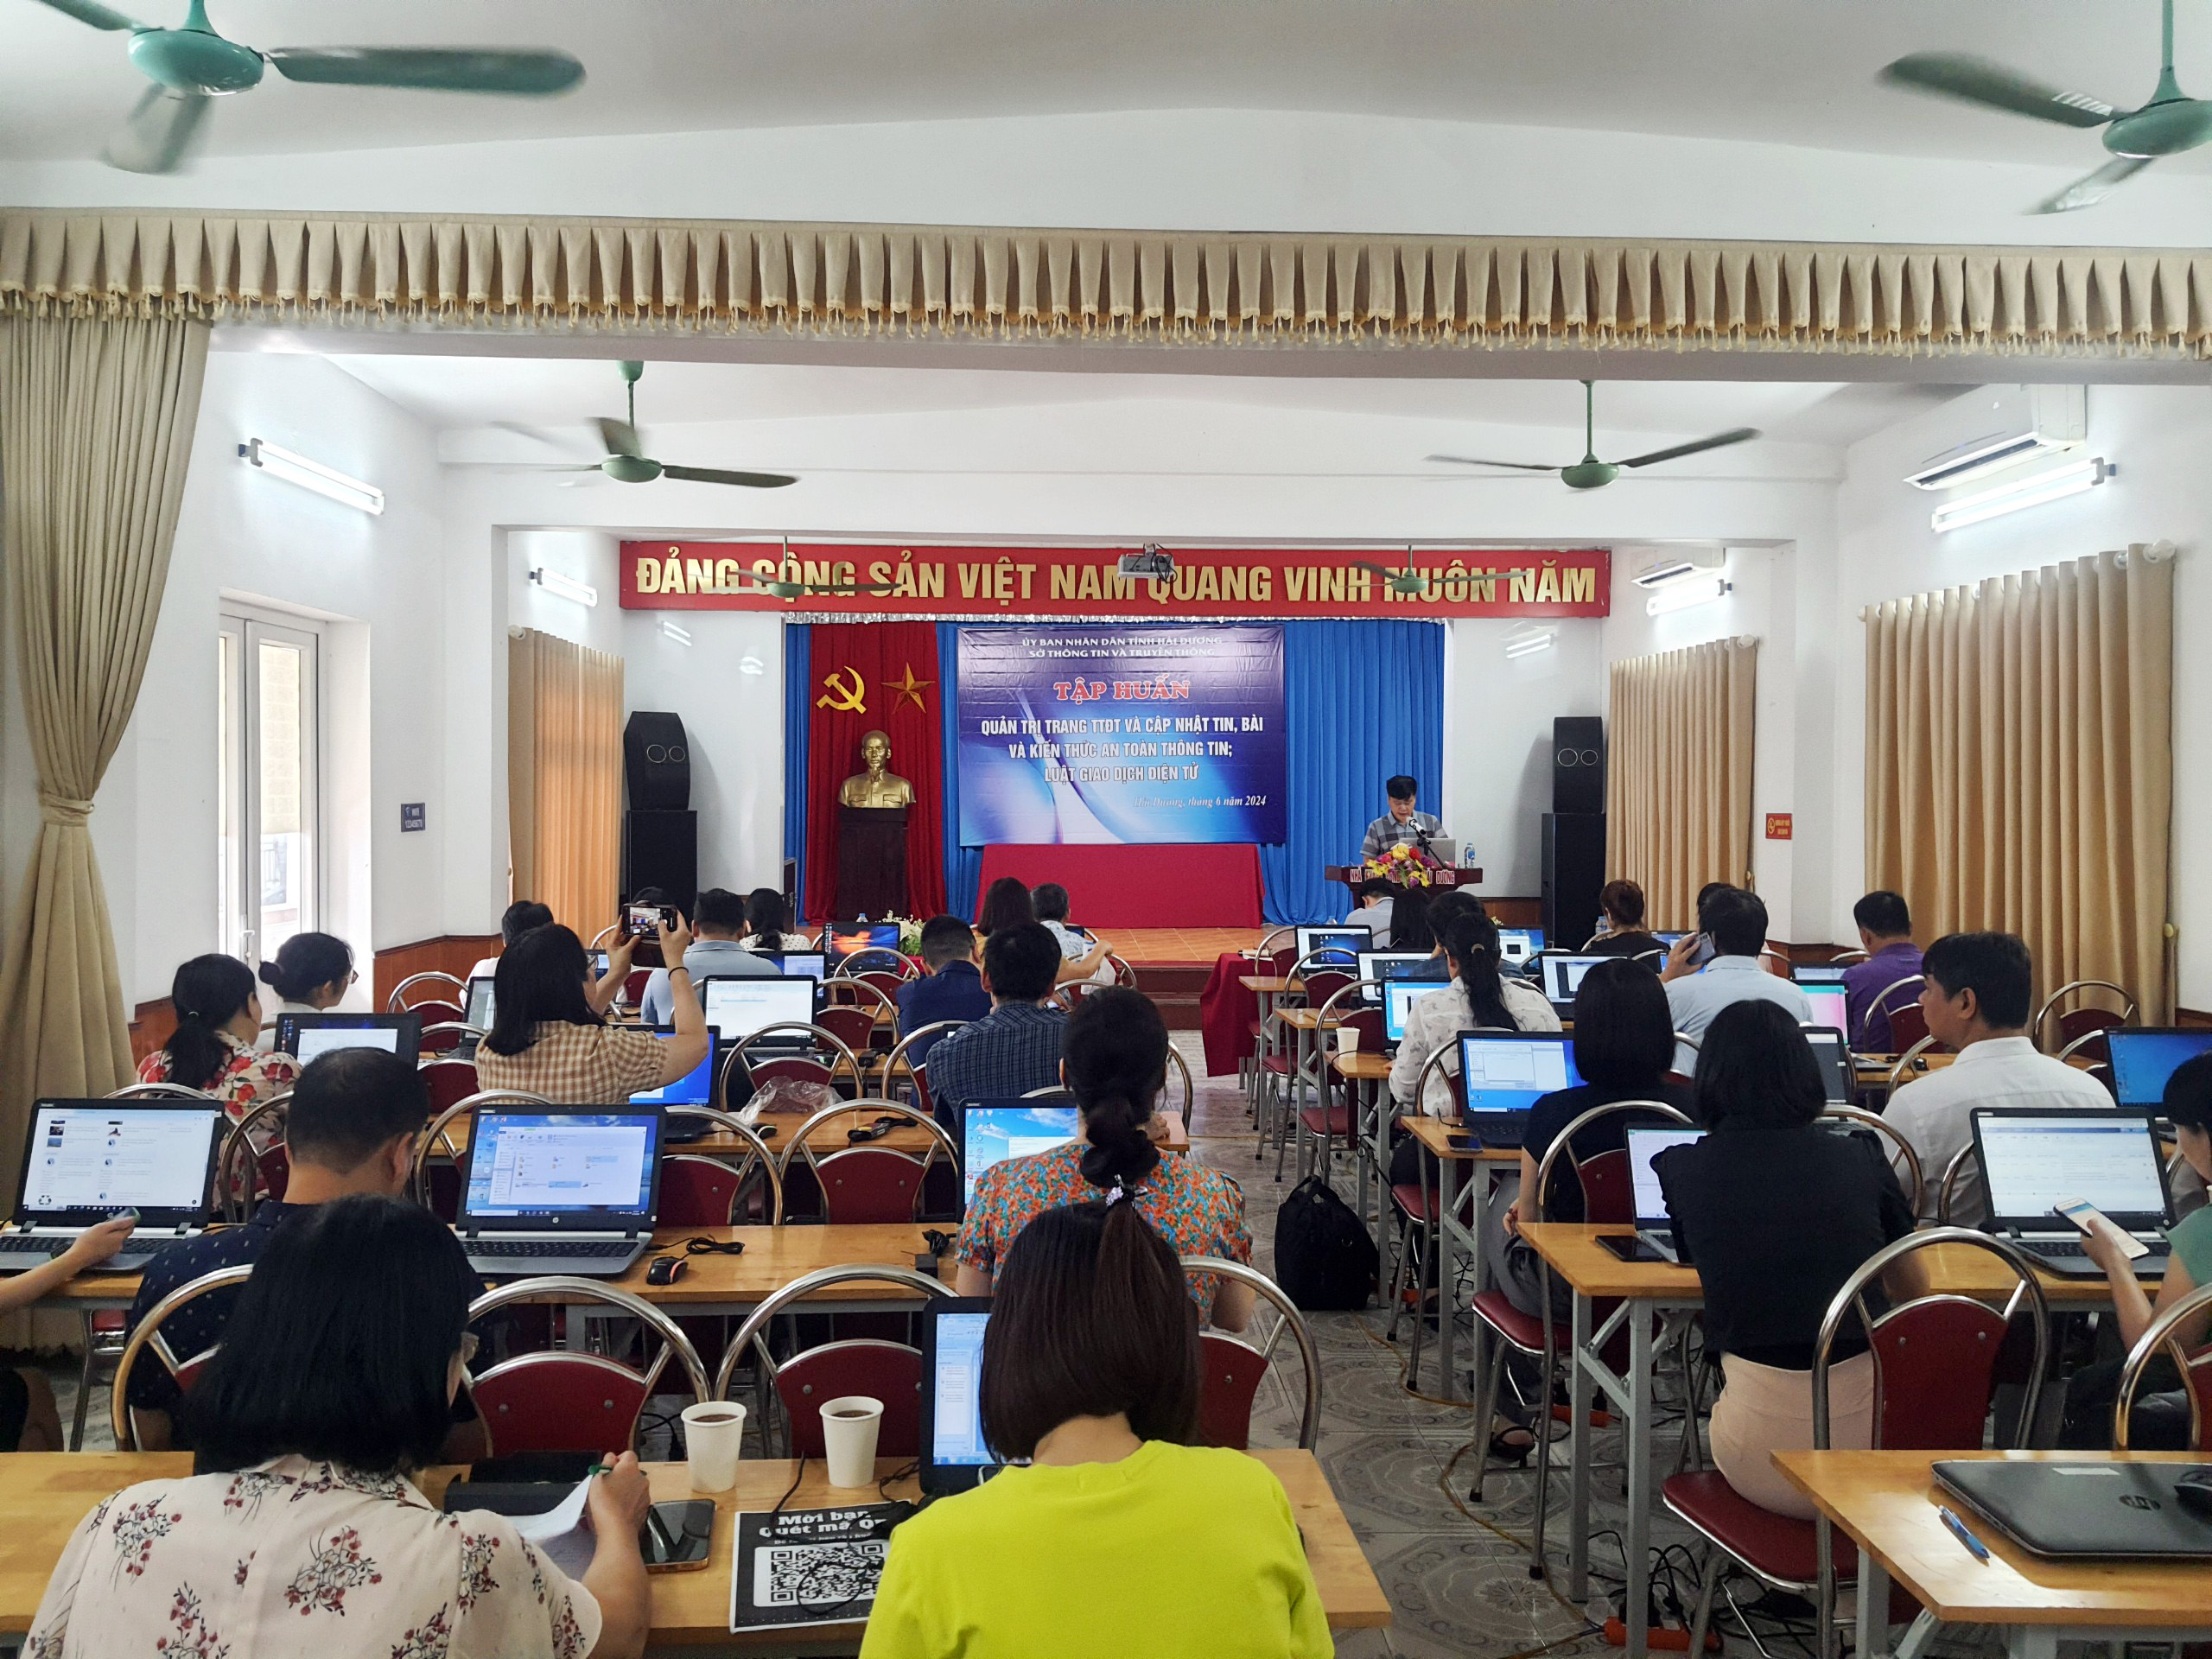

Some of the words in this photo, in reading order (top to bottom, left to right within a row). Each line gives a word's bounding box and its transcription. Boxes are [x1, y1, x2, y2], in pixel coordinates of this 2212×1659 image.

[636, 546, 740, 594] ĐẢNG
[753, 552, 855, 602] CỘNG
[868, 550, 944, 598] SẢN
[957, 556, 1037, 606] VIỆT
[1051, 564, 1135, 600] NAM
[1147, 564, 1272, 605] QUANG
[1283, 566, 1371, 602] VINH
[1384, 559, 1497, 602] MUÔN
[1509, 559, 1596, 603] NĂM
[1039, 638, 1063, 646] BAN
[1065, 637, 1098, 646] NHÂN
[1101, 636, 1125, 645] DÂN
[1179, 636, 1223, 645] DƯƠNG
[1029, 648, 1045, 658] SỞ
[1047, 648, 1089, 658] THÔNG
[1111, 647, 1127, 657] VÀ
[1175, 646, 1215, 656] THÔNG
[1053, 676, 1107, 705] TẬP
[1112, 673, 1190, 700] HUẤN
[981, 715, 1018, 736] QUẢN
[1020, 719, 1042, 737] TRỊ
[1045, 719, 1087, 734] TRANG
[1091, 718, 1121, 734] TTĐT
[1124, 715, 1142, 733] VÀ
[1145, 715, 1171, 735] CẬP
[1175, 714, 1210, 735] NHẬT
[1212, 717, 1238, 734] TIN,
[1241, 714, 1263, 732] BÀI
[1009, 741, 1026, 759] VÀ
[1029, 739, 1061, 759] KIẾN
[1064, 740, 1097, 759] THỨC
[1101, 743, 1120, 758] AN
[1123, 740, 1158, 757] TOÀN
[1160, 739, 1204, 757] THÔNG
[1207, 741, 1233, 758] TIN;
[1045, 764, 1076, 785] LUẬT
[1079, 766, 1110, 783] GIAO
[1114, 766, 1145, 785] DỊCH
[1181, 760, 1199, 781] TỬ
[1188, 796, 1213, 809] tháng
[1216, 796, 1221, 806] 6
[1224, 796, 1243, 806] năm
[1244, 795, 1267, 806] 2024
[779, 1513, 823, 1526] Mời
[859, 1518, 887, 1530] Q
